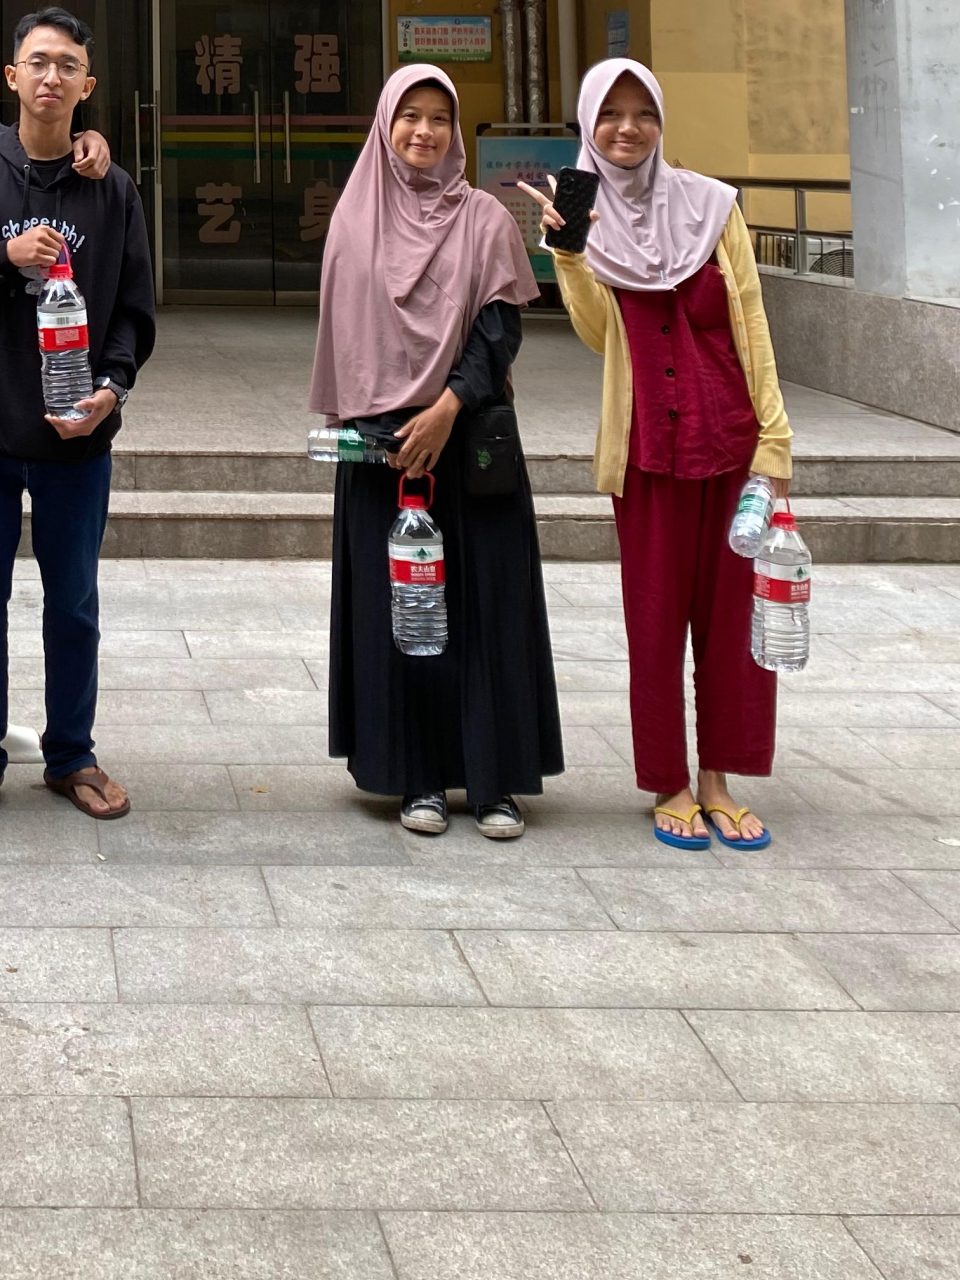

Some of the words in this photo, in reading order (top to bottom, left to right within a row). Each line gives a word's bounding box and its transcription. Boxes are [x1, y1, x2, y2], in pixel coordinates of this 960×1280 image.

[195, 34, 243, 95] 精
[294, 34, 341, 94] 强
[195, 182, 242, 243] 艺
